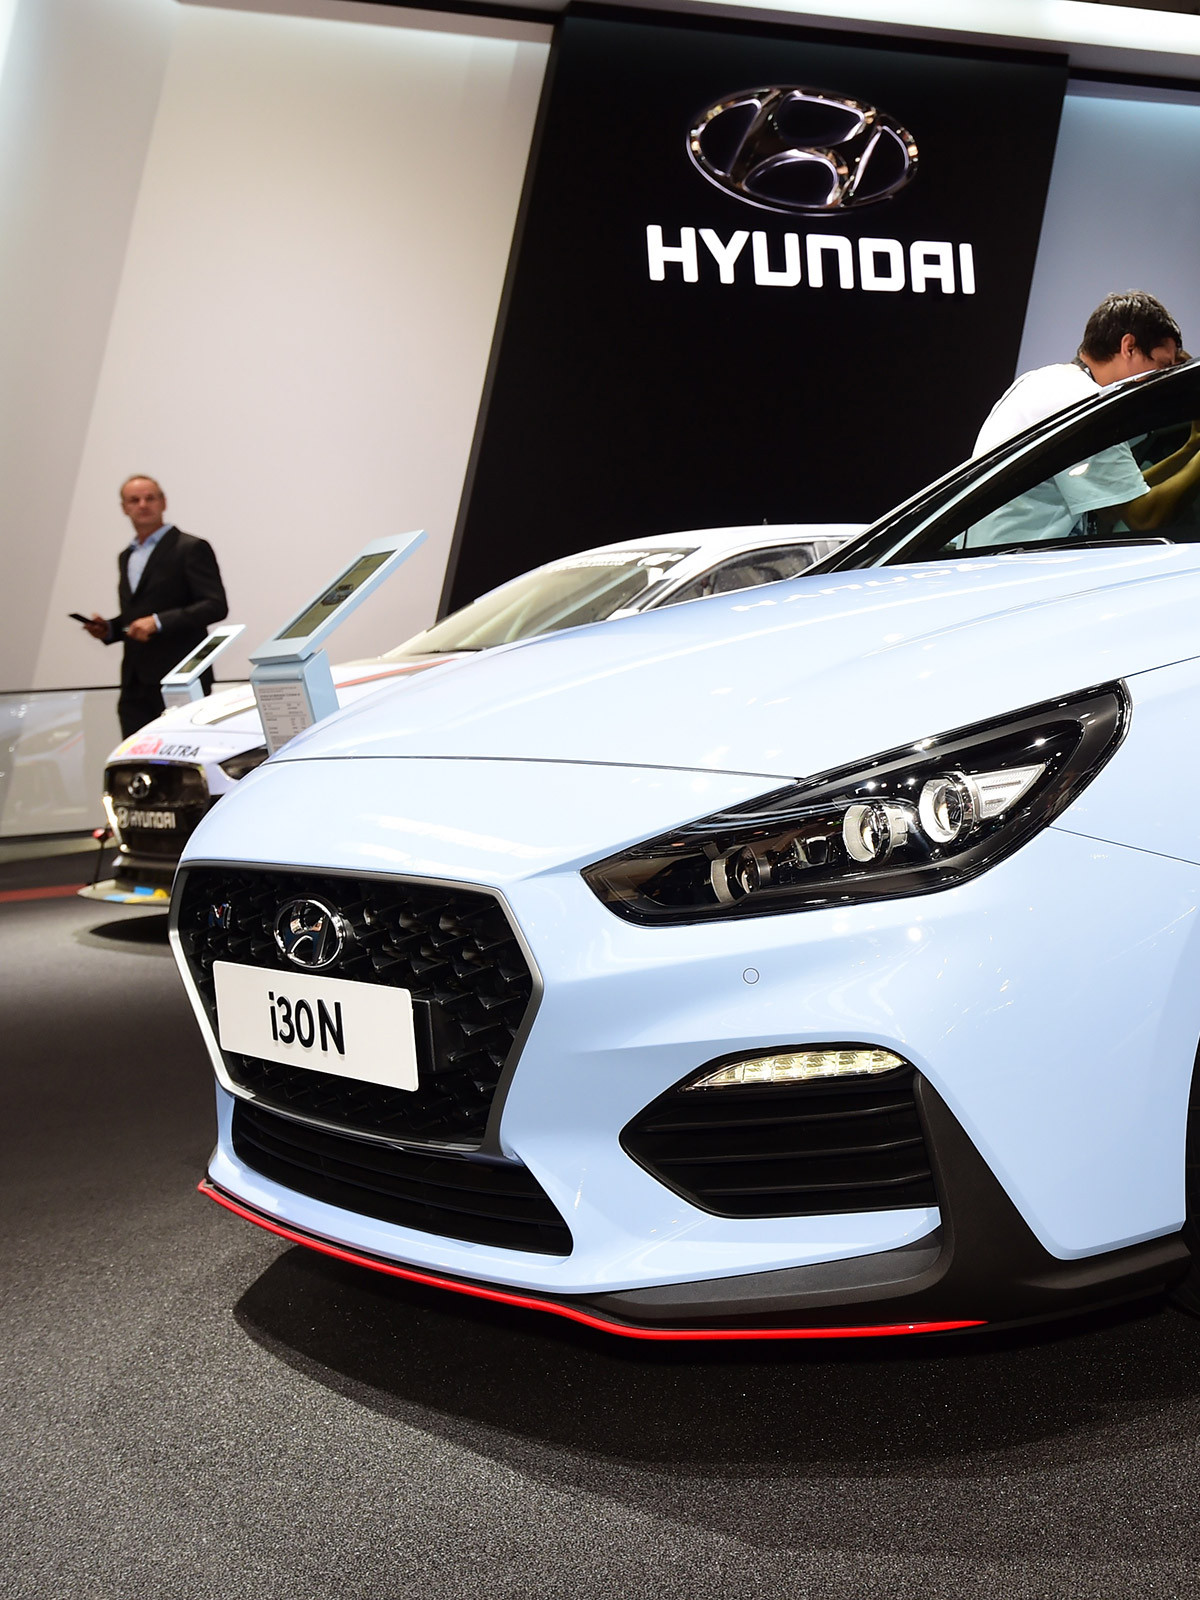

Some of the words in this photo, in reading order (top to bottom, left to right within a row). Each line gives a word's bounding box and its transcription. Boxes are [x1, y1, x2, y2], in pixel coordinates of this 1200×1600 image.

[646, 224, 976, 295] HYUNDAI
[159, 744, 200, 757] ULTRA
[130, 810, 176, 829] HYUNDAI
